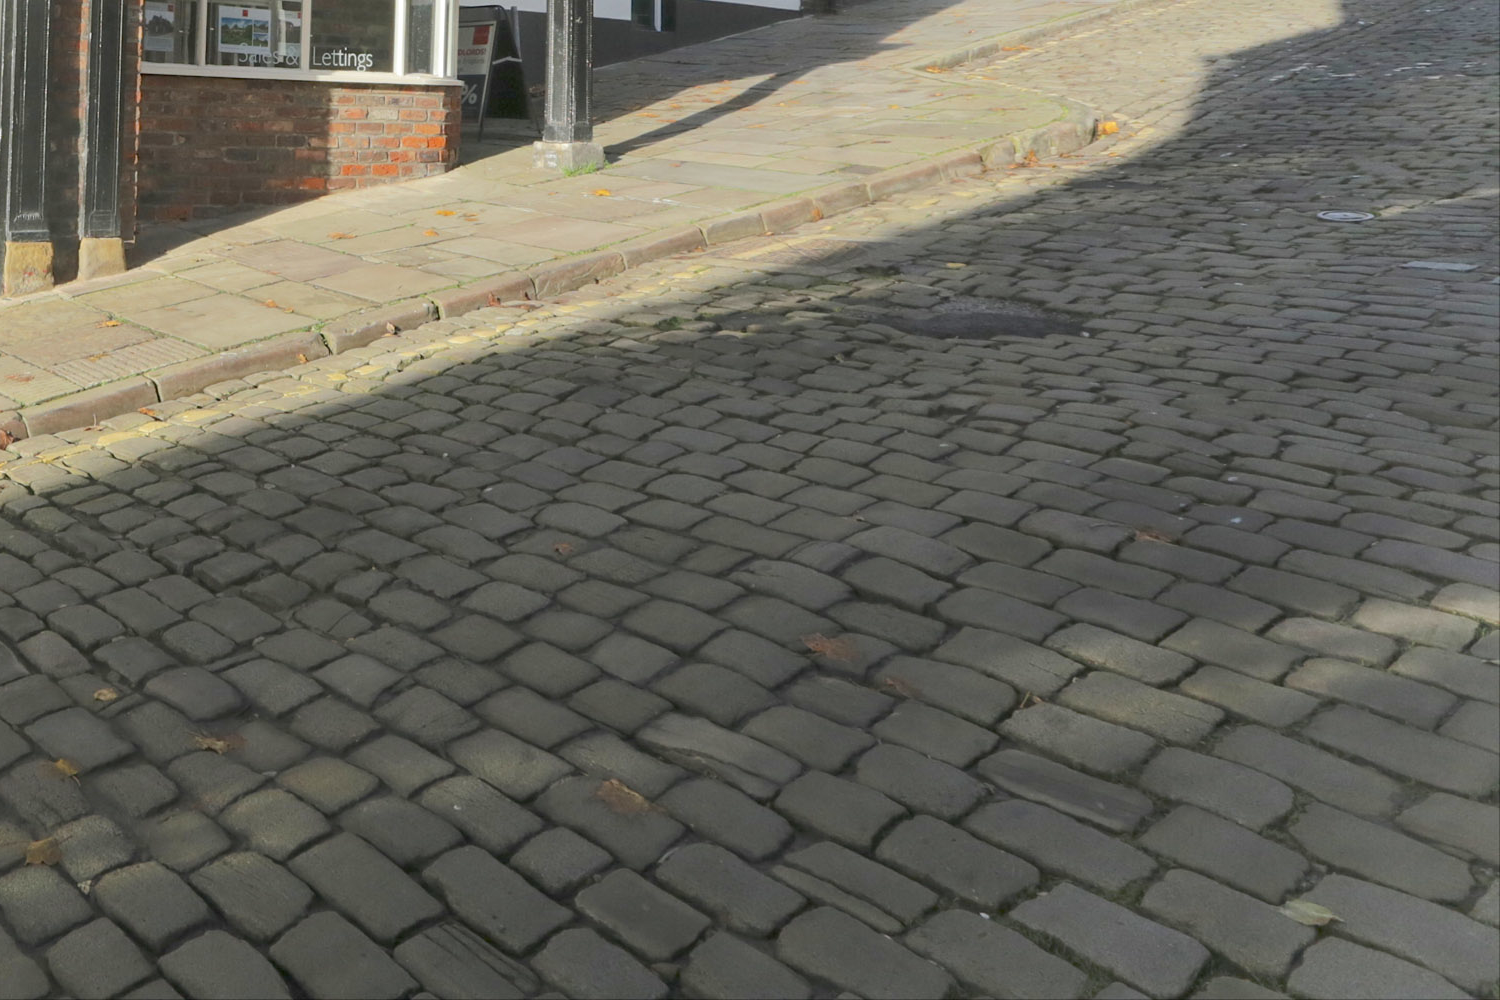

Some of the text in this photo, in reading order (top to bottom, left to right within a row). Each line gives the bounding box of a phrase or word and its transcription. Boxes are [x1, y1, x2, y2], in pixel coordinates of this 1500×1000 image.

[239, 42, 373, 72] Sales & Lettings
